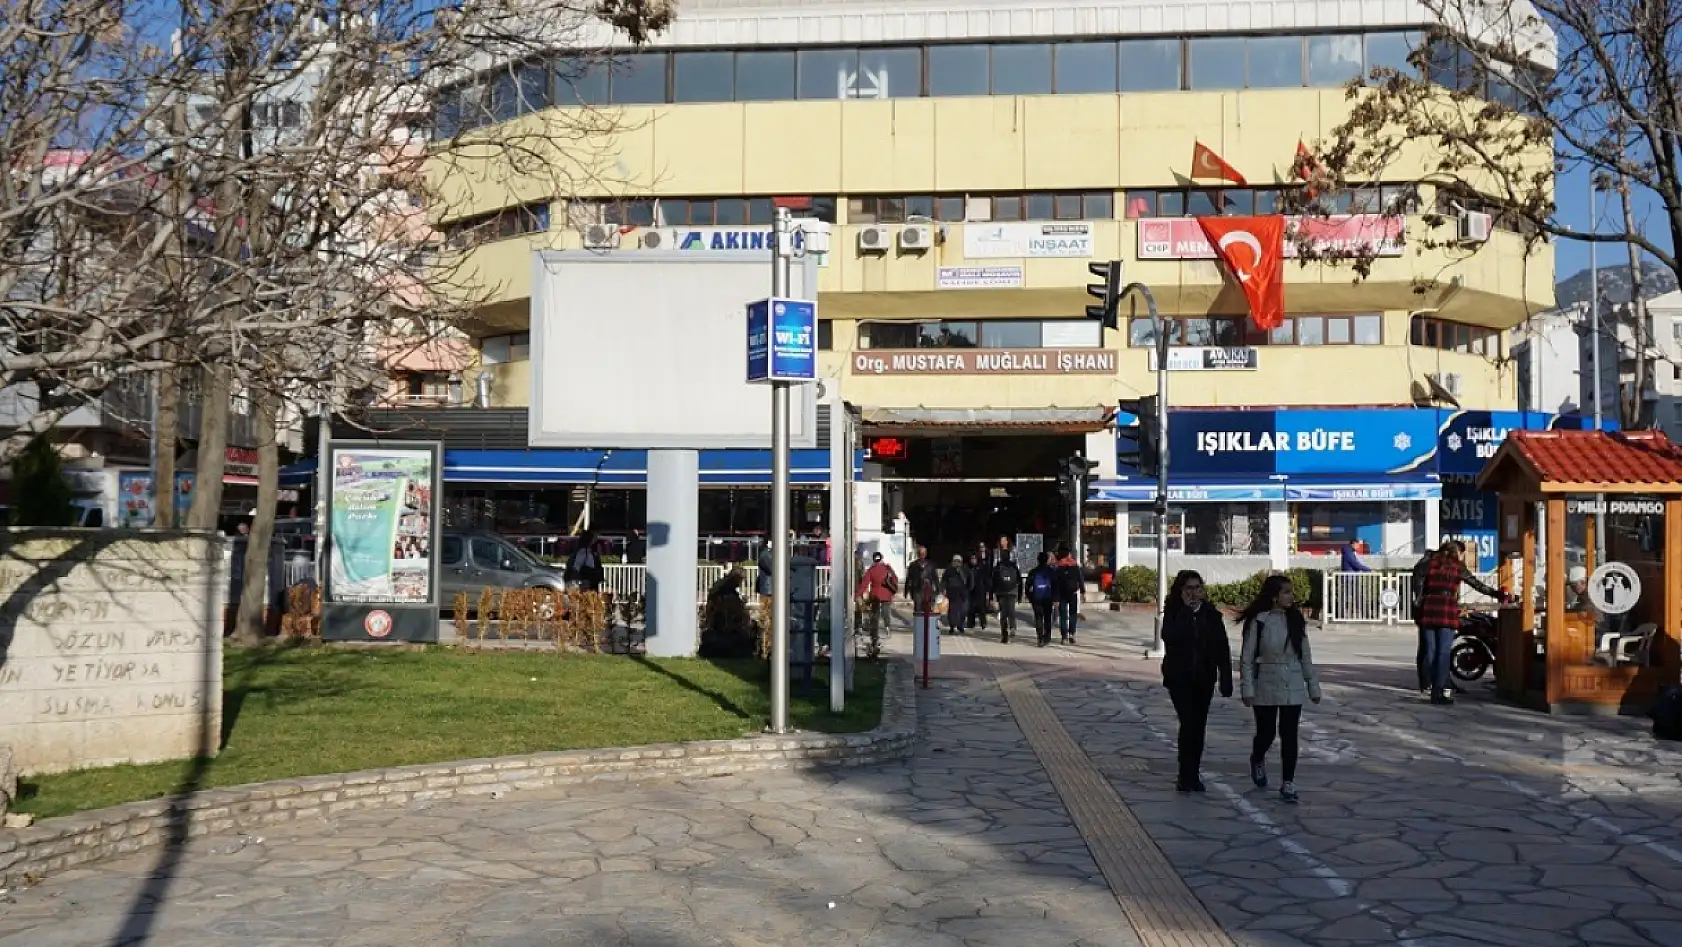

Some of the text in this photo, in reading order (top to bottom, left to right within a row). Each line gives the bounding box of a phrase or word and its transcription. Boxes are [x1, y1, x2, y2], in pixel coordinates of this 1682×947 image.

[855, 350, 1114, 374] Org. MUSTAFA MUĞLALI İŞHANI
[1196, 427, 1356, 456] IŞIKLAR BÜFE
[1441, 499, 1484, 526] SATIŞ
